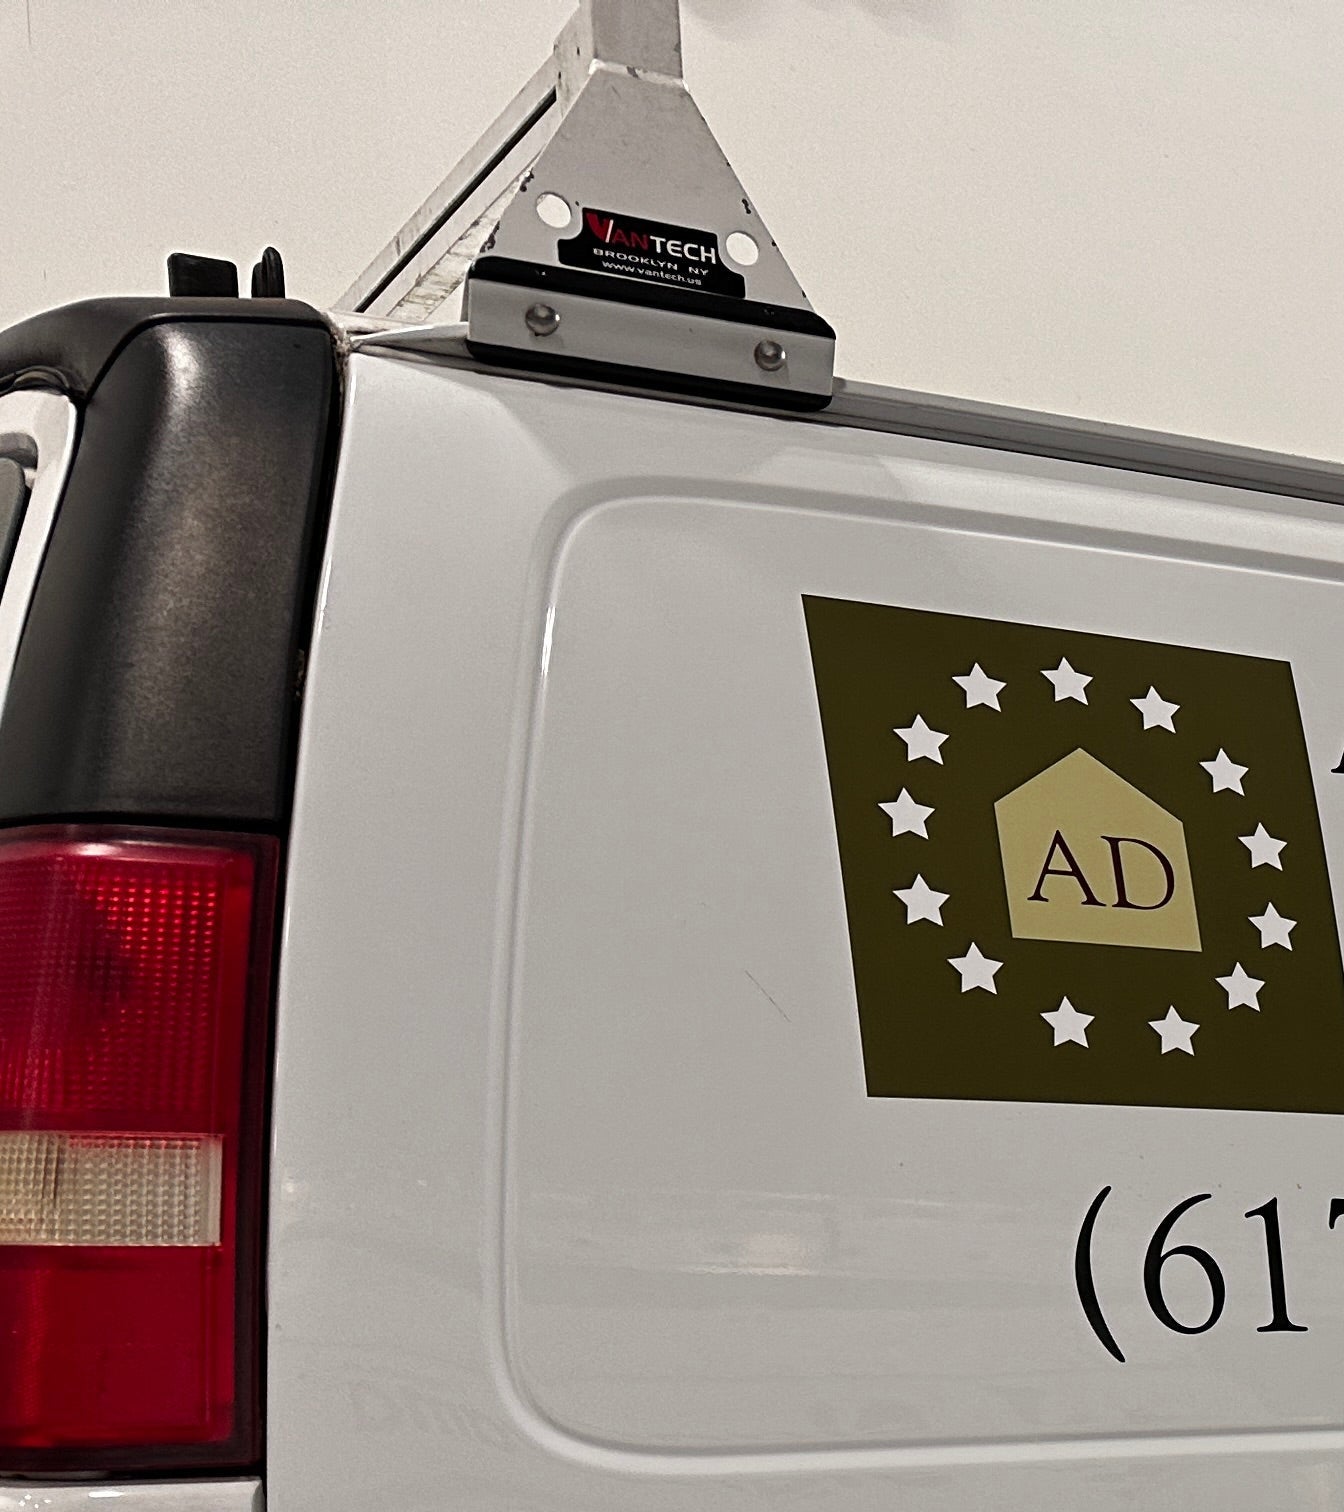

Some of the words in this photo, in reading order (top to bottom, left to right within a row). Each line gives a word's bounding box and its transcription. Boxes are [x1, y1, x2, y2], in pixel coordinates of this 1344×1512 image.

[585, 212, 717, 264] VANTECH
[592, 248, 678, 271] BROOKLYN
[688, 266, 709, 276] NY
[602, 261, 702, 286] www.vantech.us
[1027, 830, 1174, 910] AD
